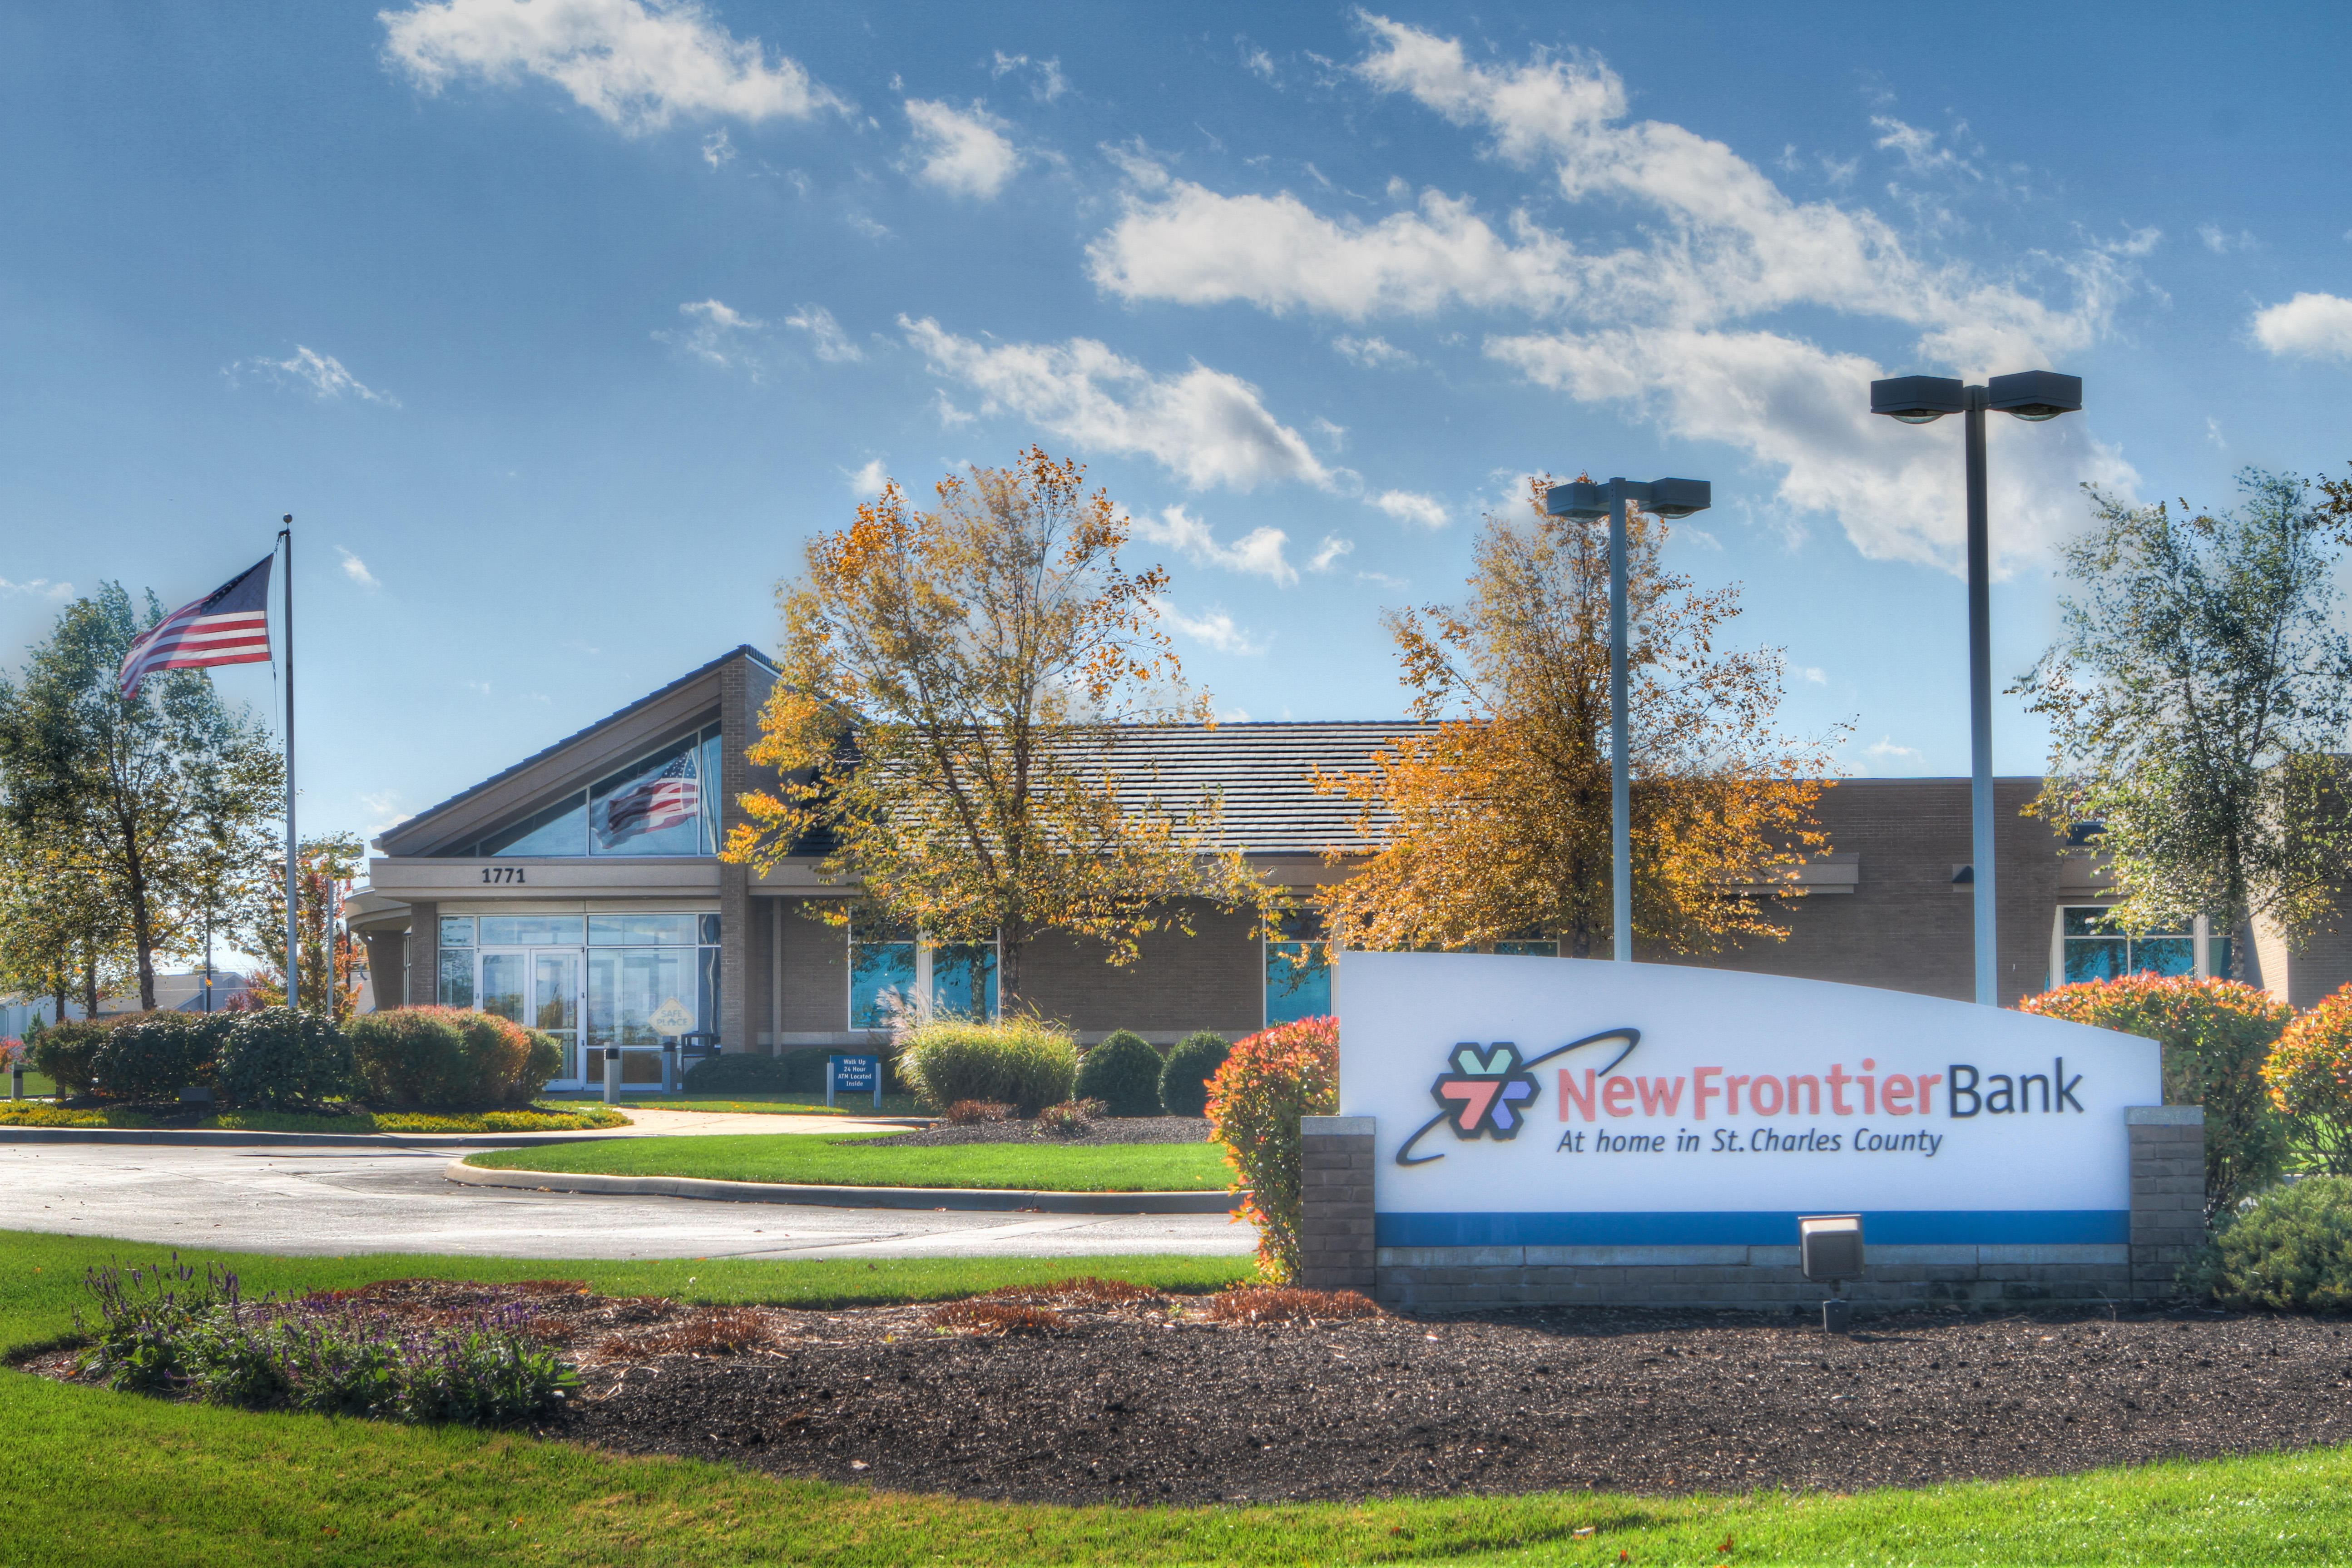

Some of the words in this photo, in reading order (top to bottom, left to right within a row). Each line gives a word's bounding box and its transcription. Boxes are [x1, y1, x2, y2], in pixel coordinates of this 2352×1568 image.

[482, 868, 525, 883] 1771
[1557, 1130, 1585, 1153] At
[1596, 1129, 1665, 1152] home
[1677, 1128, 1700, 1152] in
[1854, 1128, 1943, 1157] County
